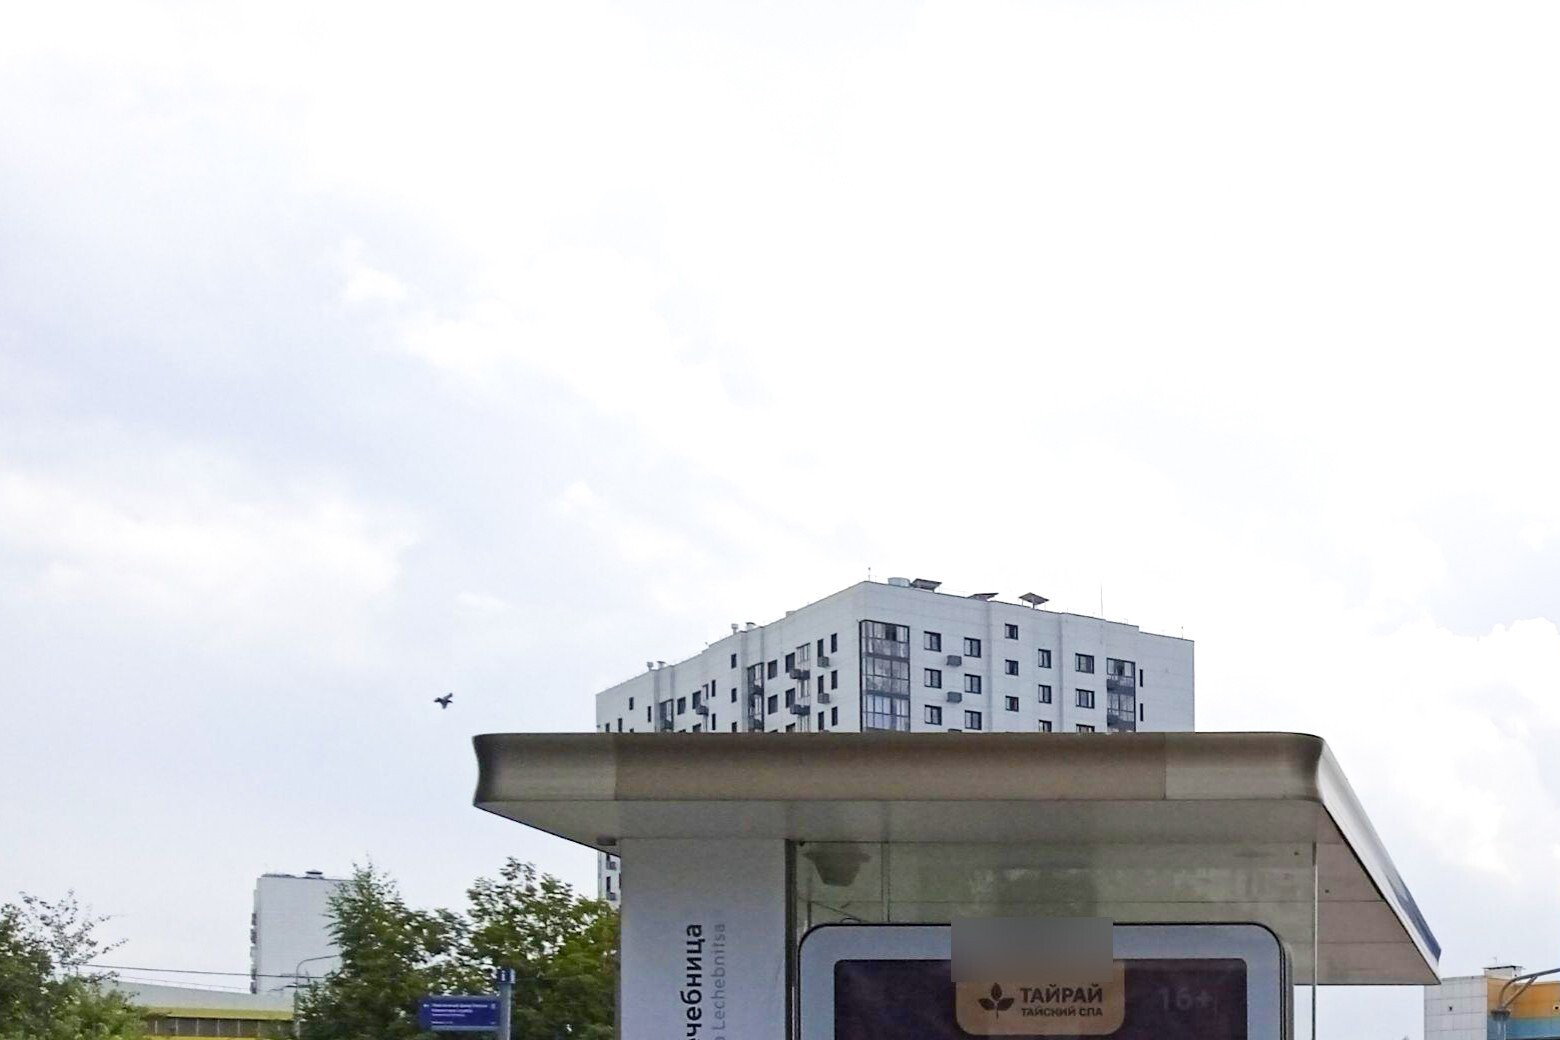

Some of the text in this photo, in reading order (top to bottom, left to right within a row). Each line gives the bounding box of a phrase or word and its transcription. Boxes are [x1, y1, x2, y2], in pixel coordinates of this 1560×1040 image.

[711, 924, 726, 1031] Lechebnitsa
[1020, 983, 1103, 1003] ТАЙРАЙ
[1021, 1006, 1103, 1017] ТАЙСКИЙ СПА
